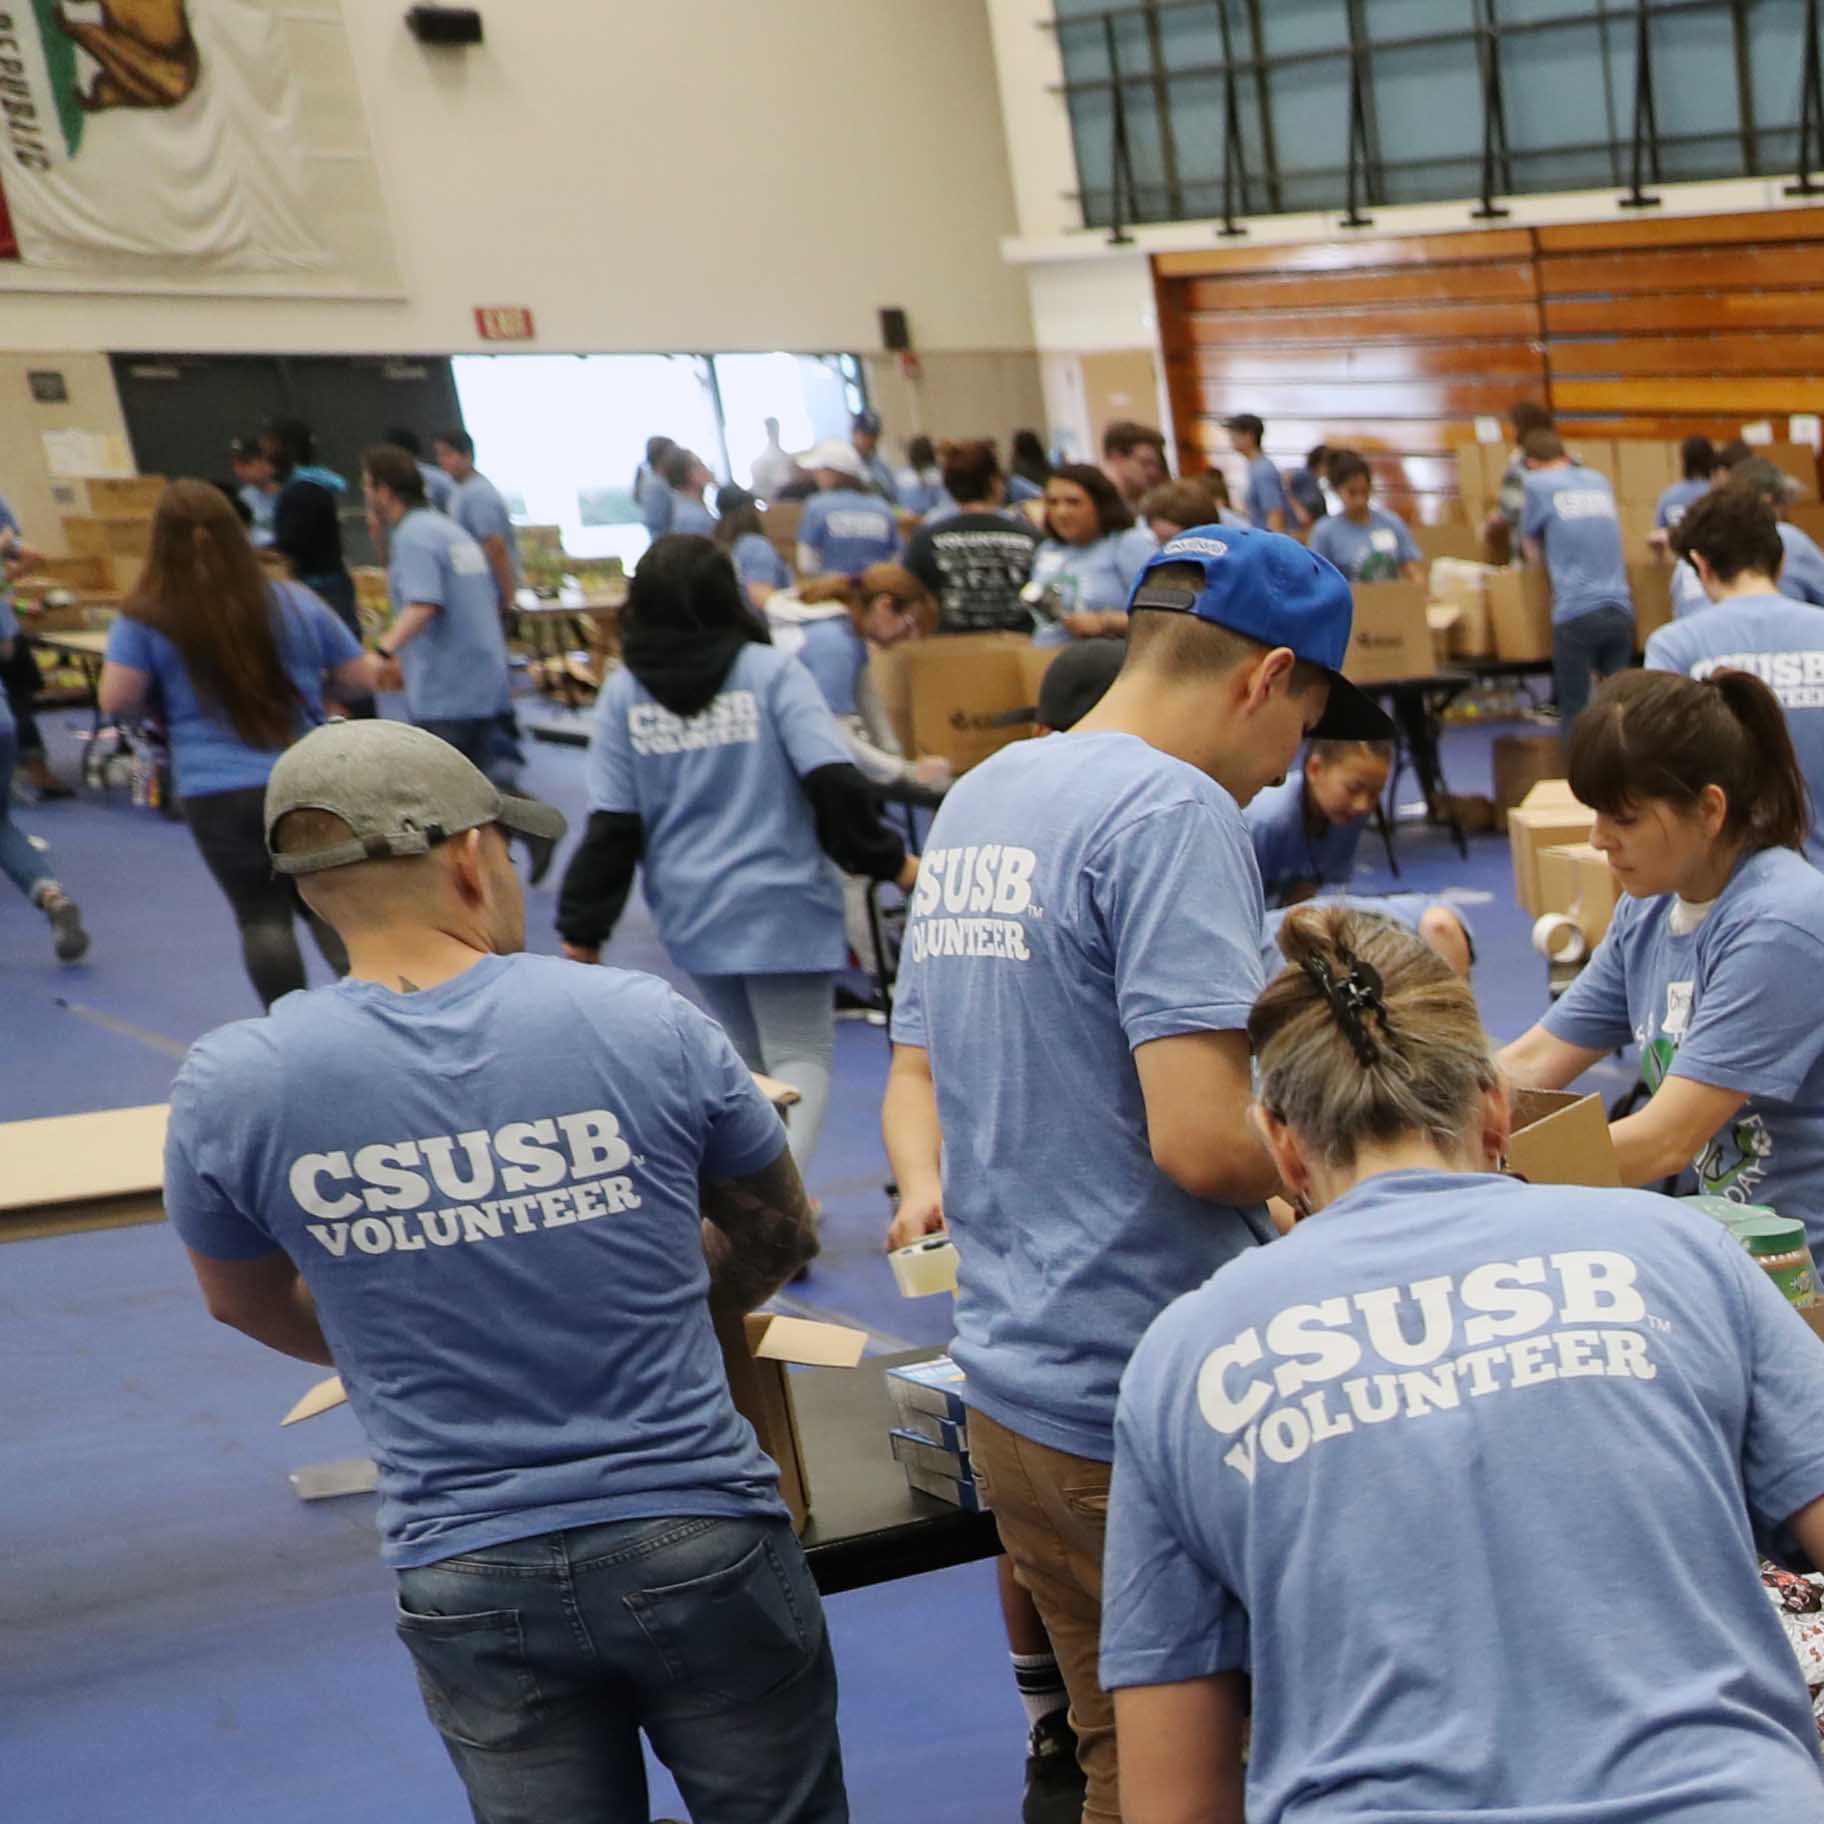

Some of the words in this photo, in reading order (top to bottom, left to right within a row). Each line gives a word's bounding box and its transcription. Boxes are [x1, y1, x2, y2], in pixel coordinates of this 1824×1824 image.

[912, 844, 1036, 919] SUSB
[289, 1109, 633, 1220] CSUSB
[1724, 1156, 1768, 1206] DAY
[307, 1174, 642, 1257] VOLUNTEER
[1196, 1249, 1646, 1436] CSUSB
[1224, 1329, 1658, 1485] VOLUNTEER
